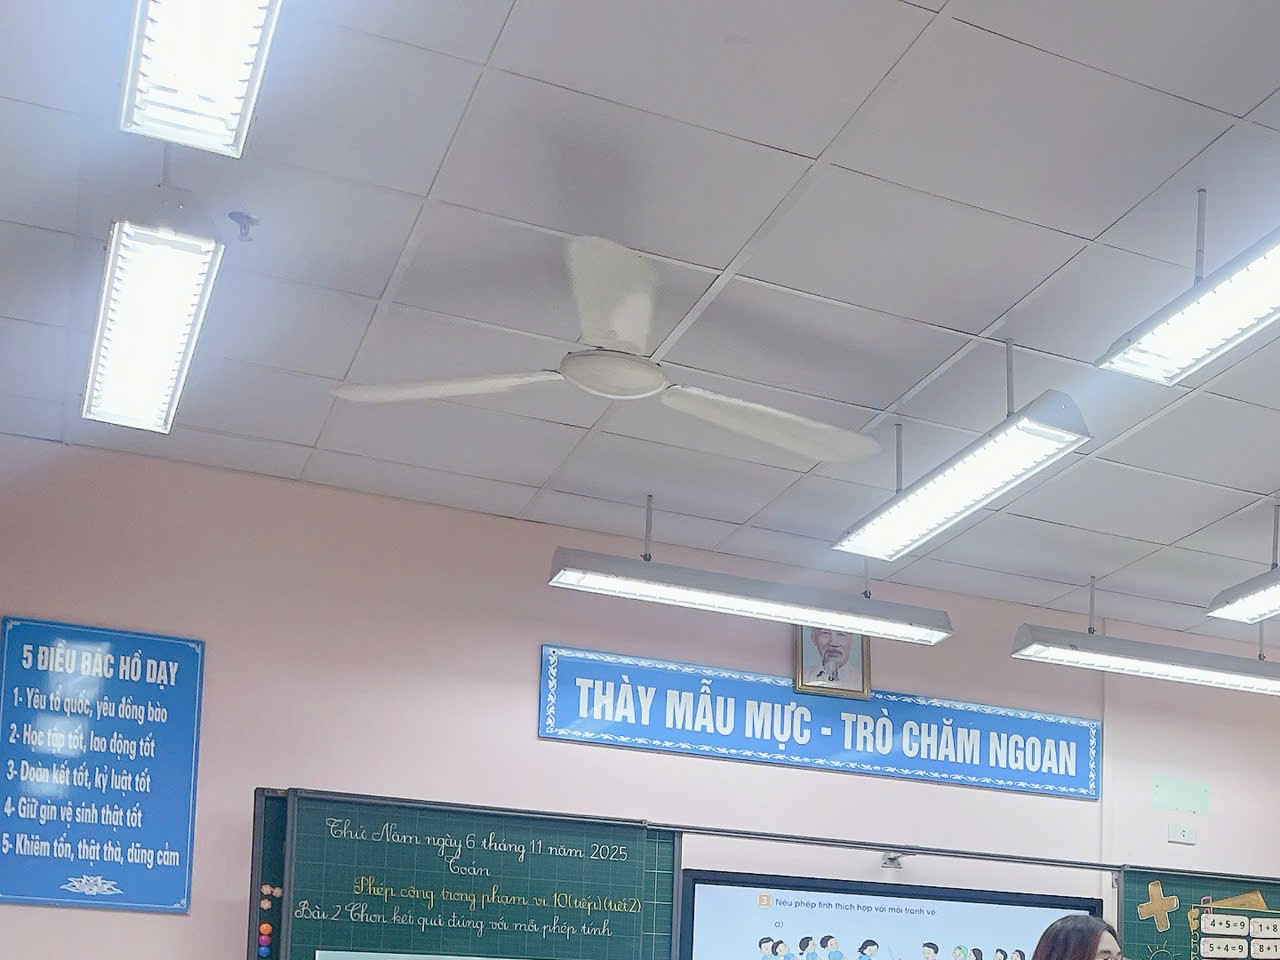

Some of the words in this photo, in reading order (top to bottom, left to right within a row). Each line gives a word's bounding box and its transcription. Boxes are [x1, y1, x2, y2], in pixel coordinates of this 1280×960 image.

[22, 644, 33, 669] 5
[37, 640, 76, 673] ĐIỀU
[80, 647, 115, 679] BÁC
[118, 650, 143, 682] HỒ
[146, 658, 178, 690] DẠY
[26, 687, 46, 710] Yêu
[50, 684, 61, 711] tổ
[63, 689, 93, 718] quốc,
[96, 695, 115, 720] yêu
[118, 695, 145, 725] đồng
[147, 701, 168, 723] bào
[23, 723, 43, 752] Học
[47, 728, 65, 753] tập
[68, 725, 87, 753] tốt,
[90, 731, 107, 752] lao
[109, 731, 137, 760] động
[139, 732, 156, 758] tốt
[575, 674, 657, 726] THÀY
[665, 678, 736, 736] MẪU
[744, 700, 812, 751] MỰC
[841, 707, 893, 755] TRÒ
[902, 717, 981, 765] CHĂM
[989, 731, 1077, 777] NGOAN
[20, 759, 49, 783] Đoàn
[52, 760, 70, 785] kết
[72, 760, 92, 790] tốt,
[95, 765, 109, 793] kỷ
[111, 768, 132, 797] luật
[135, 767, 151, 793] tốt
[18, 796, 39, 819] Giữ
[39, 799, 57, 825] gìn
[60, 801, 73, 829] vệ
[75, 801, 98, 824] sinh
[101, 803, 124, 832] thật
[126, 803, 143, 828] tốt
[15, 833, 50, 857] Khiêm
[53, 833, 74, 862] tốn,
[78, 838, 101, 867] thật
[103, 840, 124, 865] thà,
[127, 843, 154, 869] dũng
[156, 842, 180, 866] cảm
[326, 817, 367, 840] Thứ
[371, 823, 420, 845] Năm
[425, 834, 462, 859] ngày
[466, 833, 476, 849] 6
[481, 832, 527, 863] tháng
[530, 839, 542, 854] 11
[548, 846, 584, 858] năm
[590, 843, 628, 861] 2025
[444, 855, 491, 877] Toán
[353, 875, 396, 903] Phép
[441, 887, 476, 911] trong
[481, 884, 528, 910] phạm
[532, 897, 548, 907] vi
[294, 899, 328, 919] Bài
[331, 904, 341, 921] 2
[392, 905, 414, 924] kết
[448, 912, 484, 937] đúng
[489, 916, 509, 930] với
[542, 915, 577, 939] phép
[580, 918, 613, 937] tính
